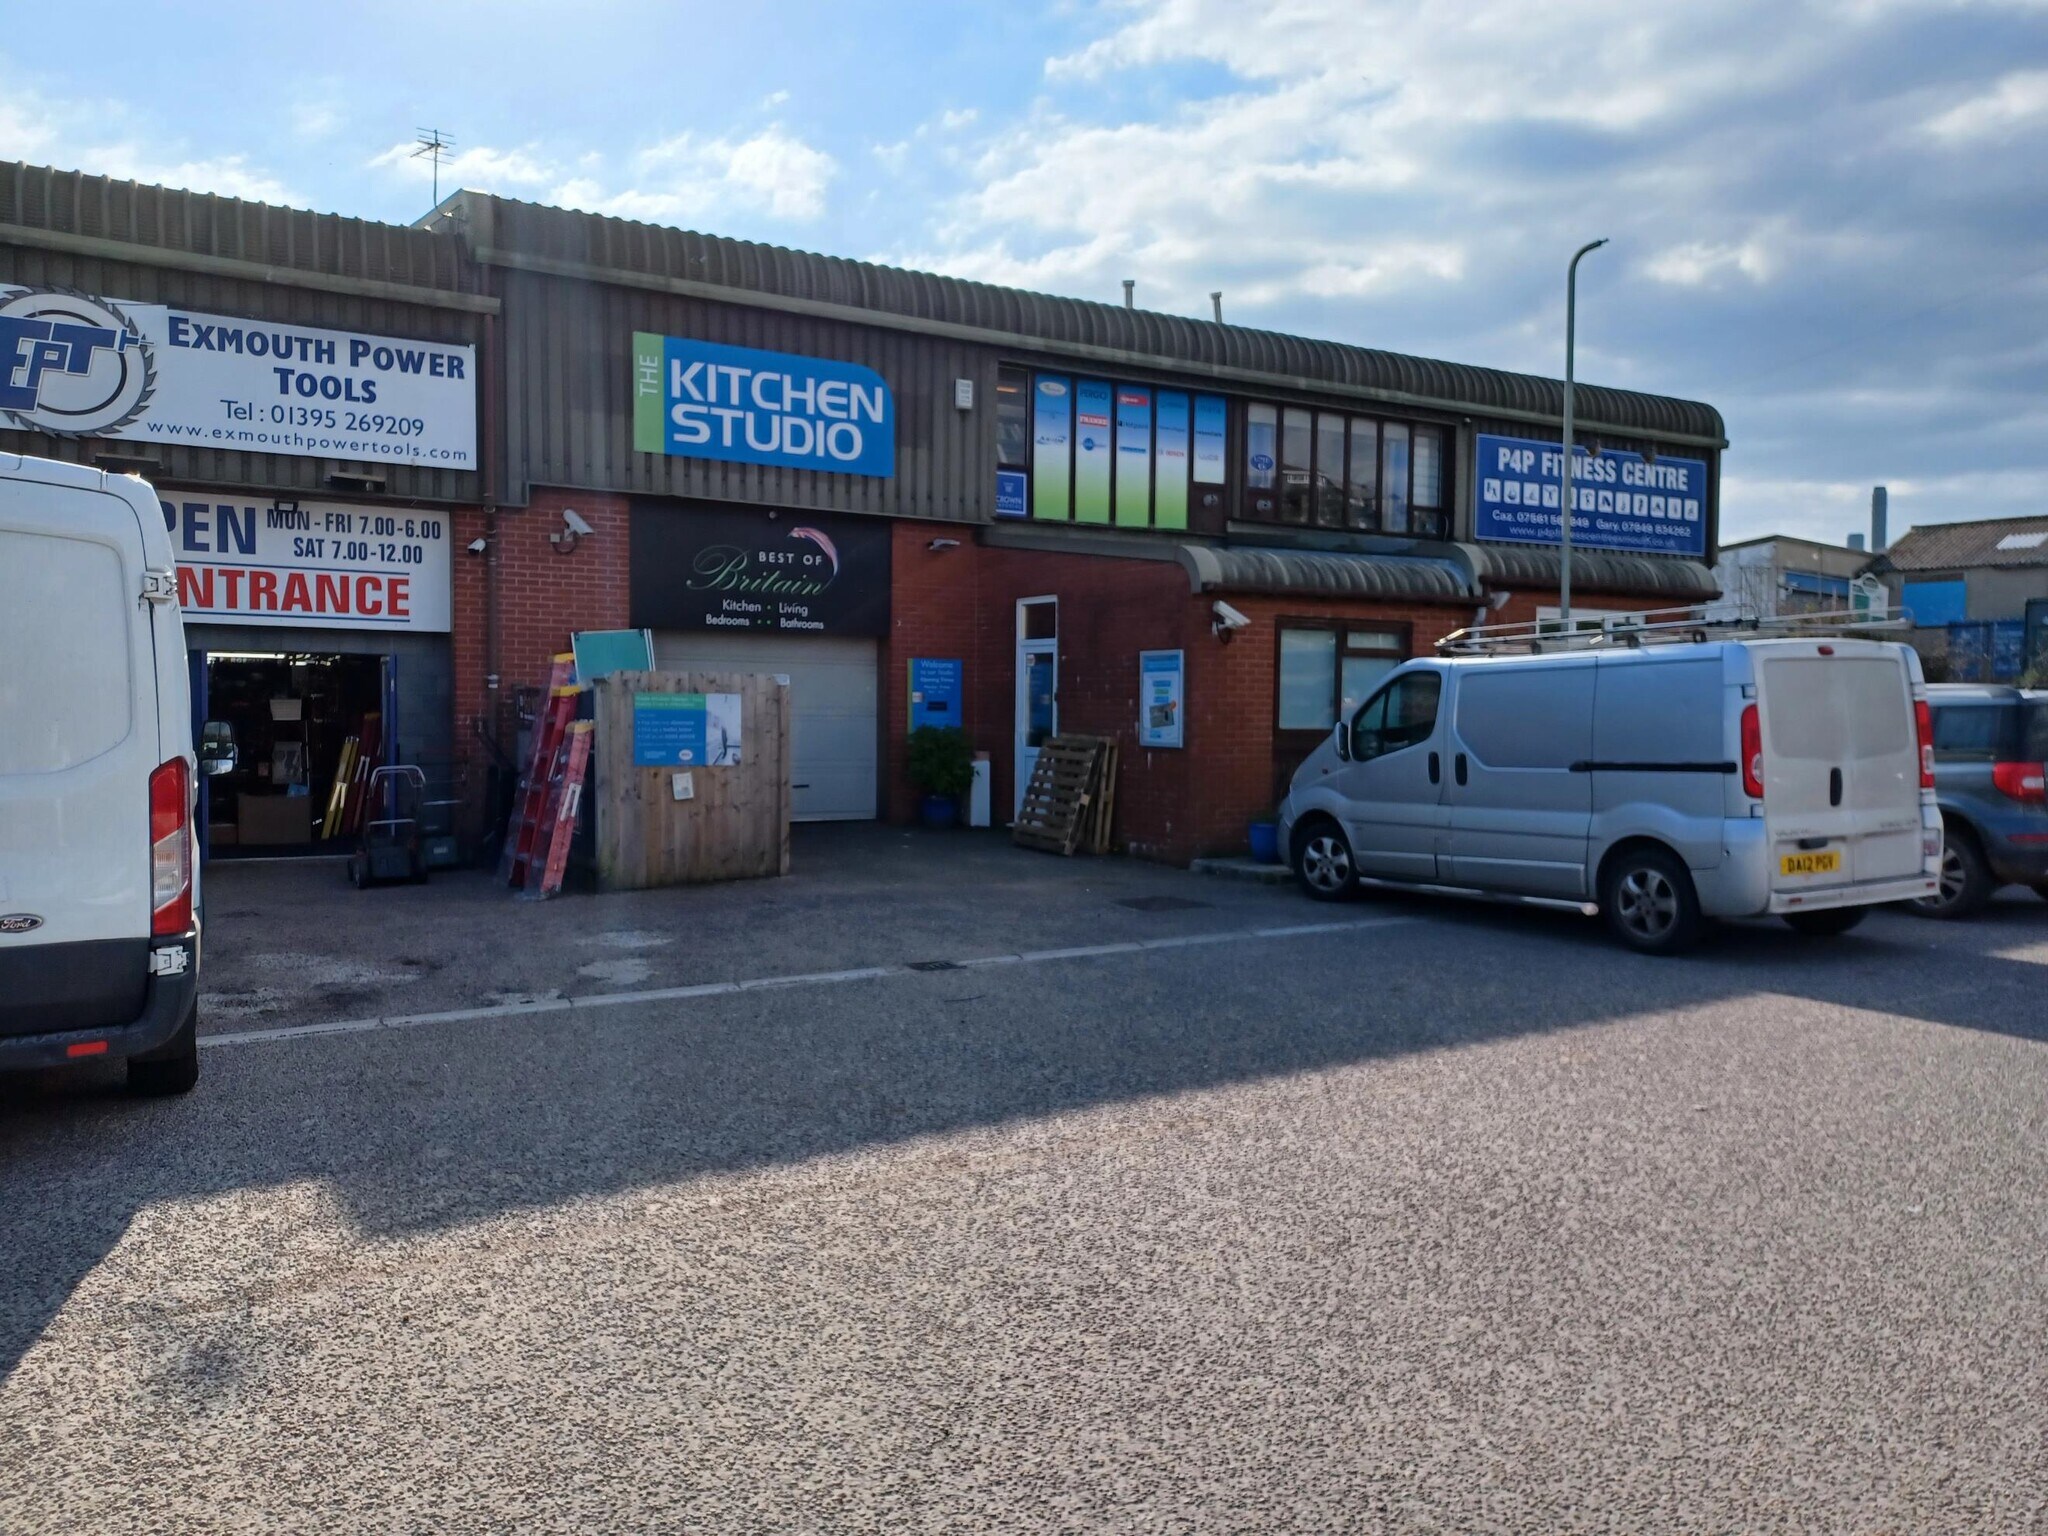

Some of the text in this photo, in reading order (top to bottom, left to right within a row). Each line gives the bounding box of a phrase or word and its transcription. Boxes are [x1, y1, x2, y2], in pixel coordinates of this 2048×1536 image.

[168, 316, 465, 379] EXMOUTH POWER
[273, 367, 377, 404] TOOLS
[639, 354, 658, 397] THE
[670, 358, 884, 424] KITCHEN
[271, 404, 336, 429] 01395
[345, 412, 424, 437] 269209
[670, 402, 863, 461] STUDIO
[147, 421, 467, 461] www.exmouthpowertools.com
[1498, 446, 1535, 475] P4P
[1622, 461, 1689, 491] CENTRE
[325, 512, 352, 534] FRI
[293, 537, 325, 559] SAT
[758, 551, 824, 566] BEST OF
[686, 544, 824, 596] Britain
[706, 613, 825, 630] Bedrooms Bathrooms
[722, 599, 809, 617] Kitchen Living
[1, 917, 32, 929] Ford
